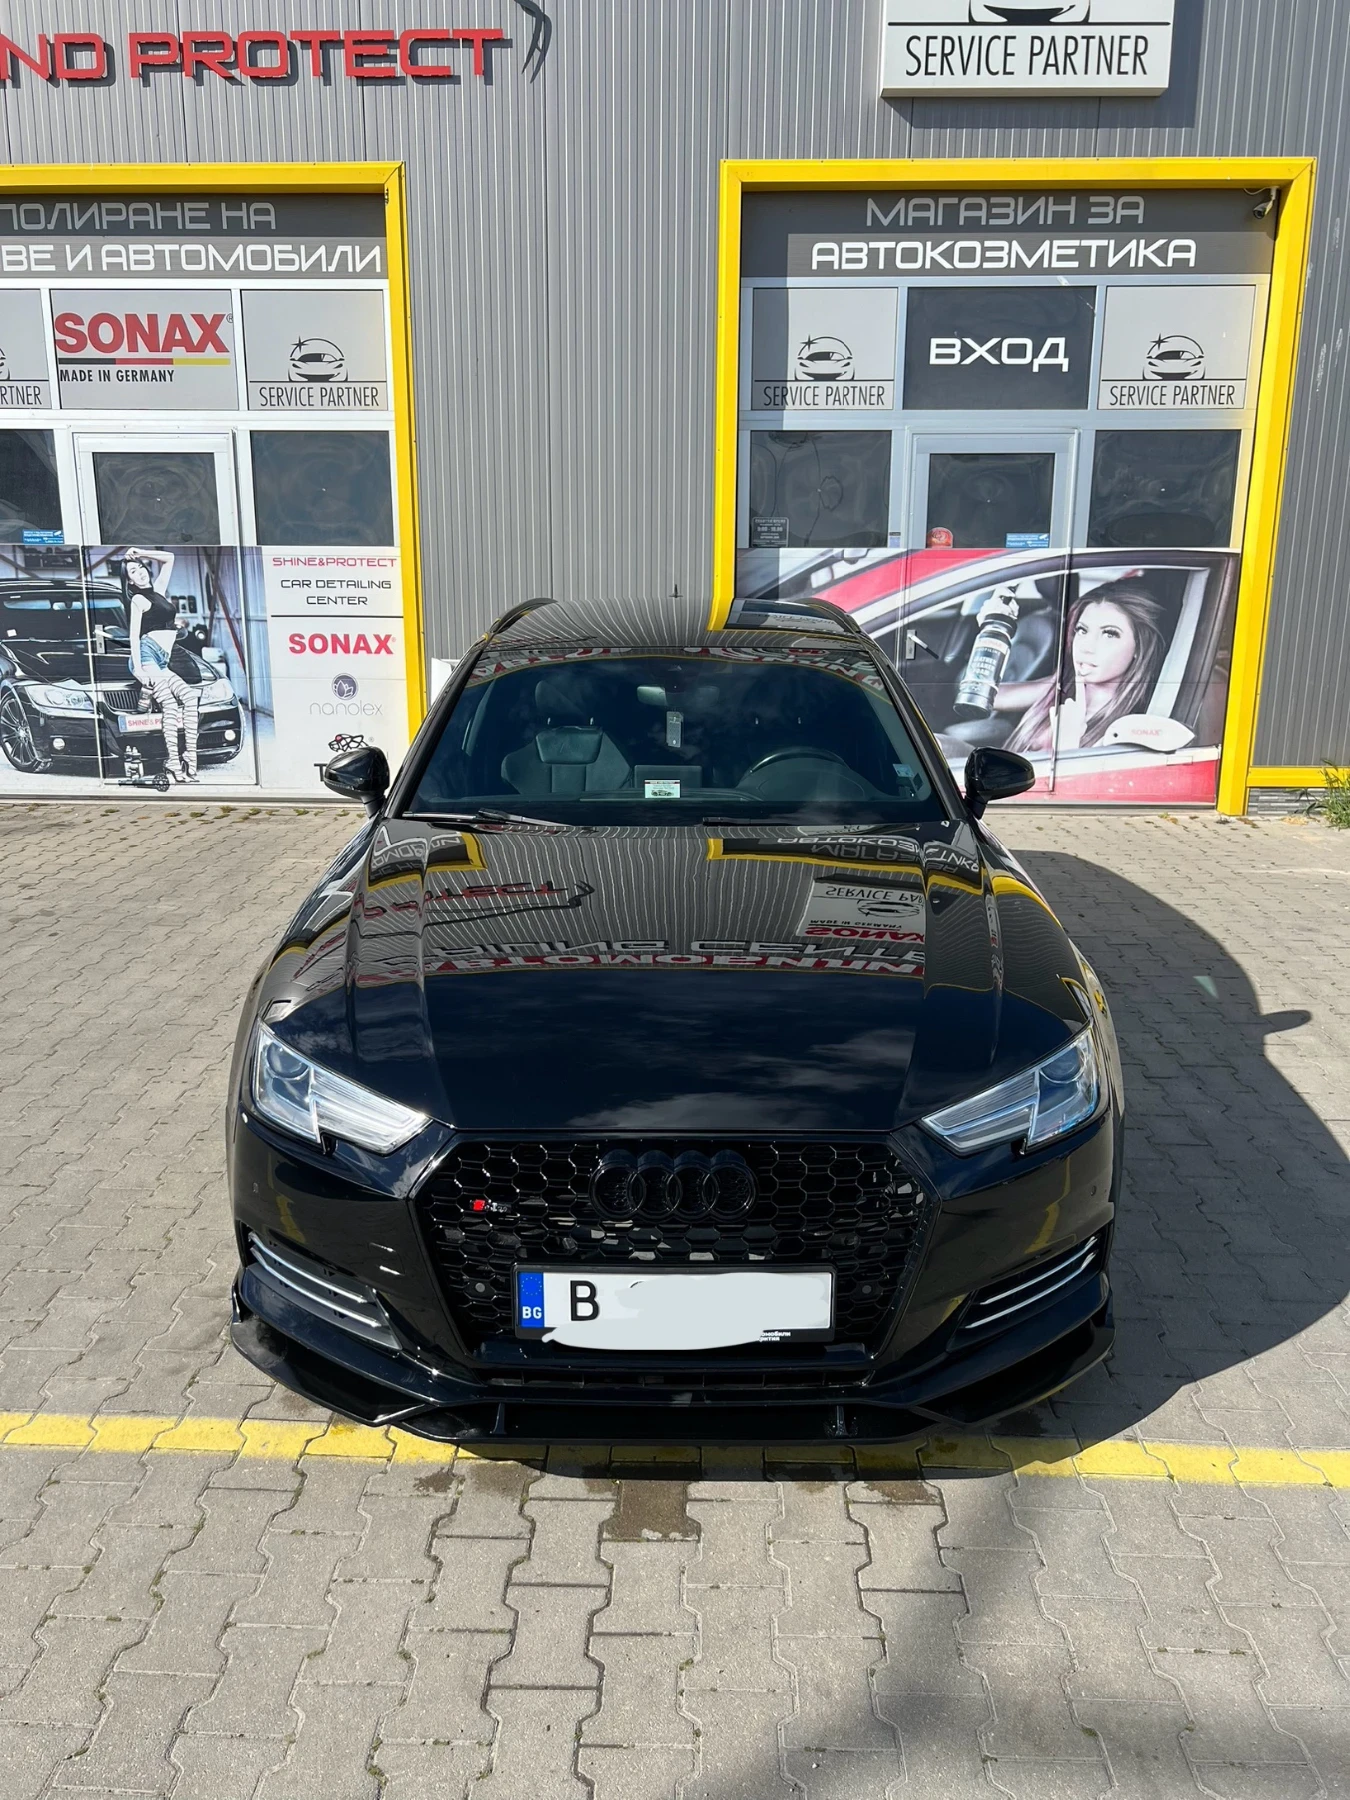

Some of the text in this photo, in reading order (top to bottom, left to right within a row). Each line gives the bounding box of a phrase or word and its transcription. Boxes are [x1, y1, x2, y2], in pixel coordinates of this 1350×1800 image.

[129, 28, 504, 79] PROTECT
[905, 34, 1149, 77] SERVICE PARTNER
[221, 202, 276, 229] НА
[866, 195, 1145, 227] МАГАЗИН ЗА
[1, 243, 381, 272] ВЕ И АВТОМОБИЛИ
[811, 238, 1197, 270] АВТОКОЗМЕТИКА
[55, 313, 229, 353] SONAX
[929, 337, 1069, 372] ВХОД
[60, 369, 175, 383] MADE IN GERMANY
[259, 386, 379, 407] SERVICE PARTNER
[763, 386, 885, 406] SERVICE PARTNER
[1110, 385, 1235, 406] SERVICE PARTNER
[272, 557, 397, 567] SHINE&PROTECT
[280, 579, 391, 589] CAR DETAILING
[306, 596, 368, 605] CENTER
[288, 633, 394, 655] SONAX
[309, 700, 383, 716] nanolex
[522, 1306, 542, 1319] BG
